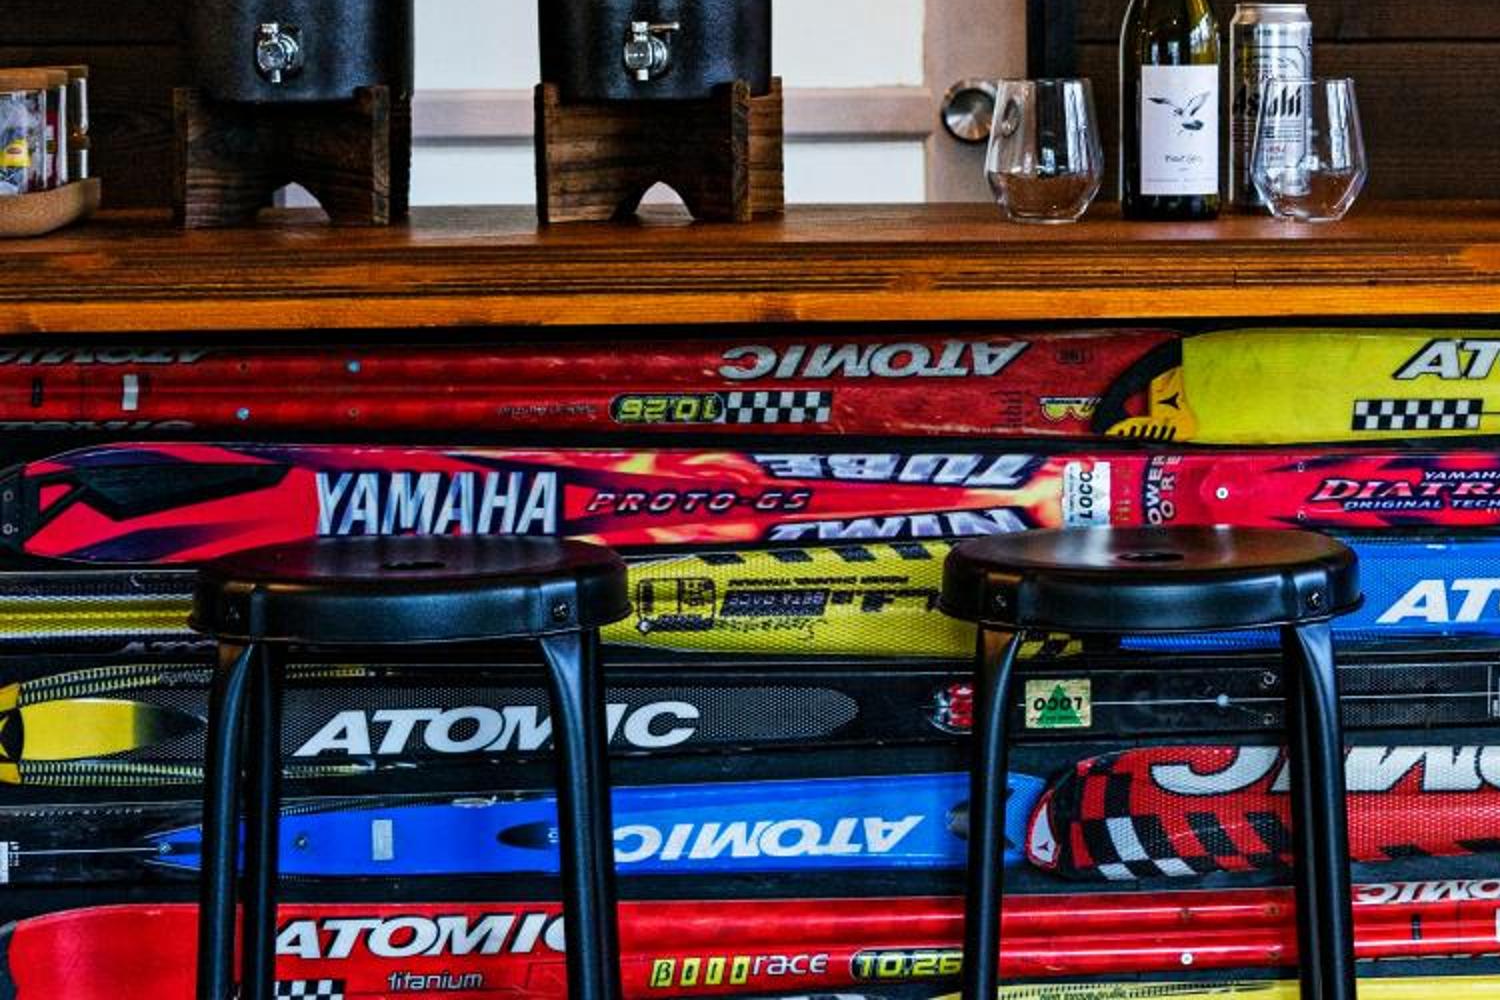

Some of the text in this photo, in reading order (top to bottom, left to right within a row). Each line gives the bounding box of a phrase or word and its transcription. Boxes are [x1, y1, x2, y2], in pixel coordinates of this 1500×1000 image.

[720, 340, 1033, 380] ATOMIC
[622, 399, 716, 420] 10.26
[753, 453, 1042, 485] TUBE
[315, 471, 558, 536] YAMAHA
[587, 492, 811, 512] PROTO GS
[1079, 472, 1093, 519] LOCO
[1343, 499, 1442, 510] ORIGINAL
[613, 815, 925, 863] ATOMIC
[388, 971, 483, 991] titanium
